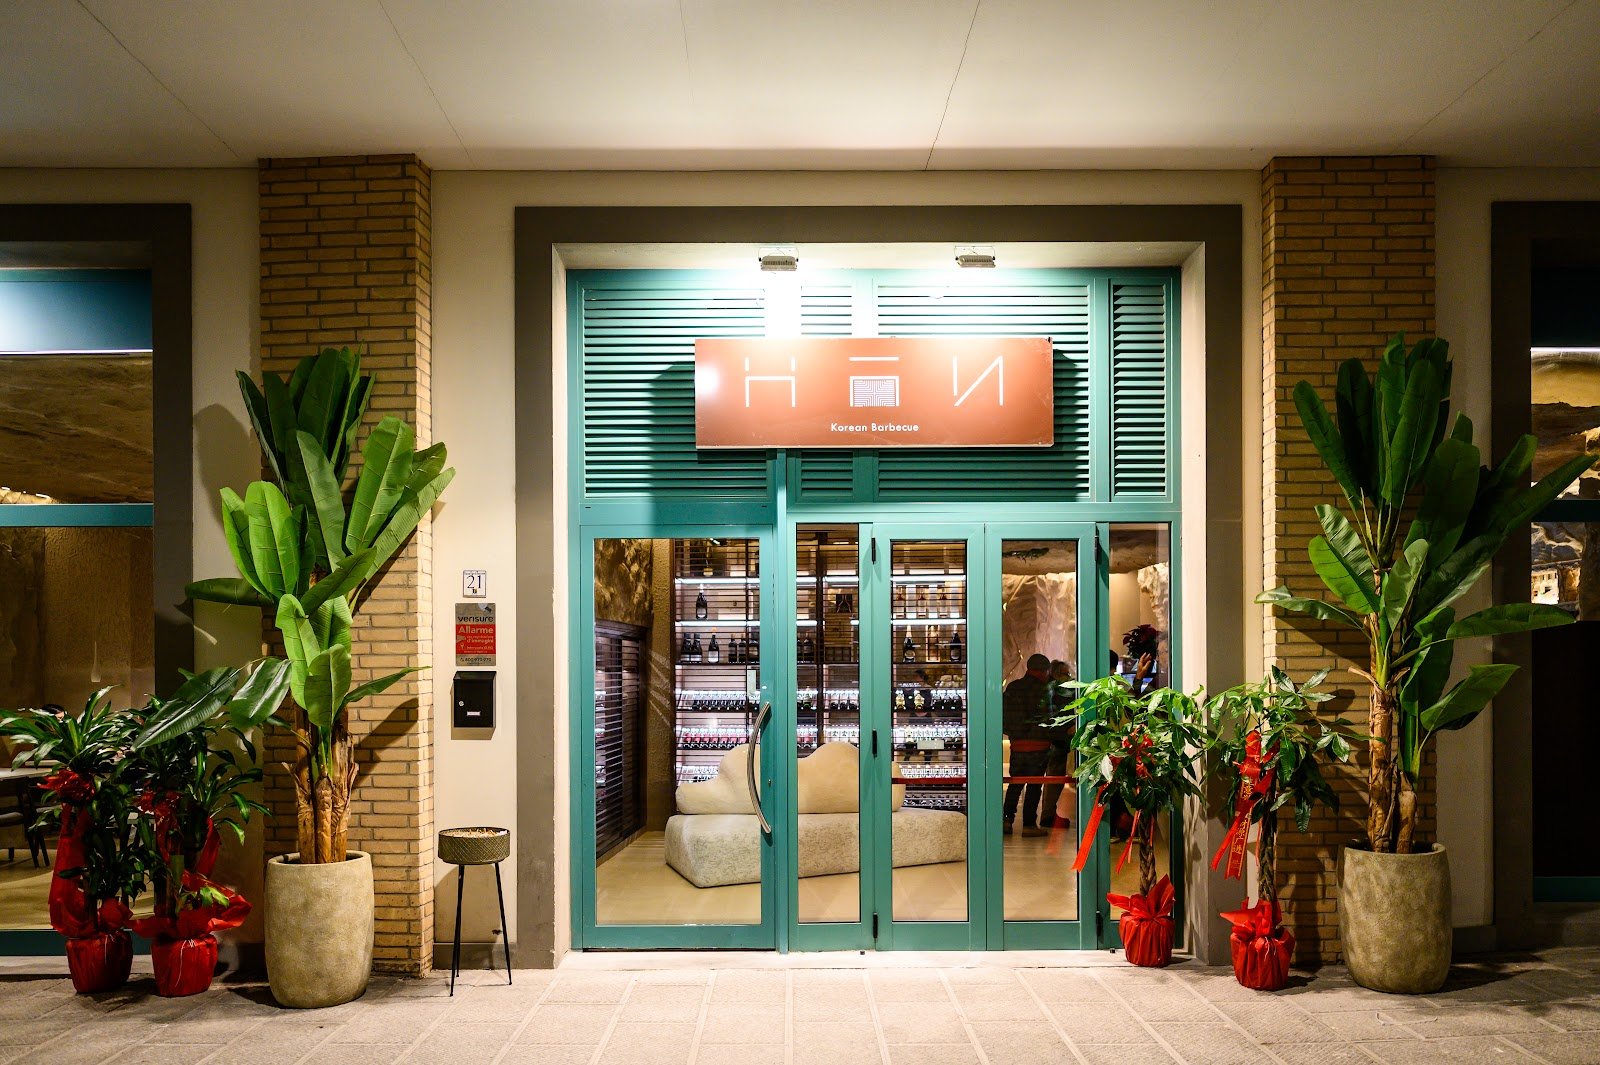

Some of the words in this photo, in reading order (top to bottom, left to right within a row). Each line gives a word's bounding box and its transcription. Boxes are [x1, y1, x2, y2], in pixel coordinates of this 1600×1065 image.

[831, 423, 868, 432] Korean
[871, 422, 919, 432] Barbecue
[466, 575, 481, 589] 21
[458, 625, 494, 634] Allarme
